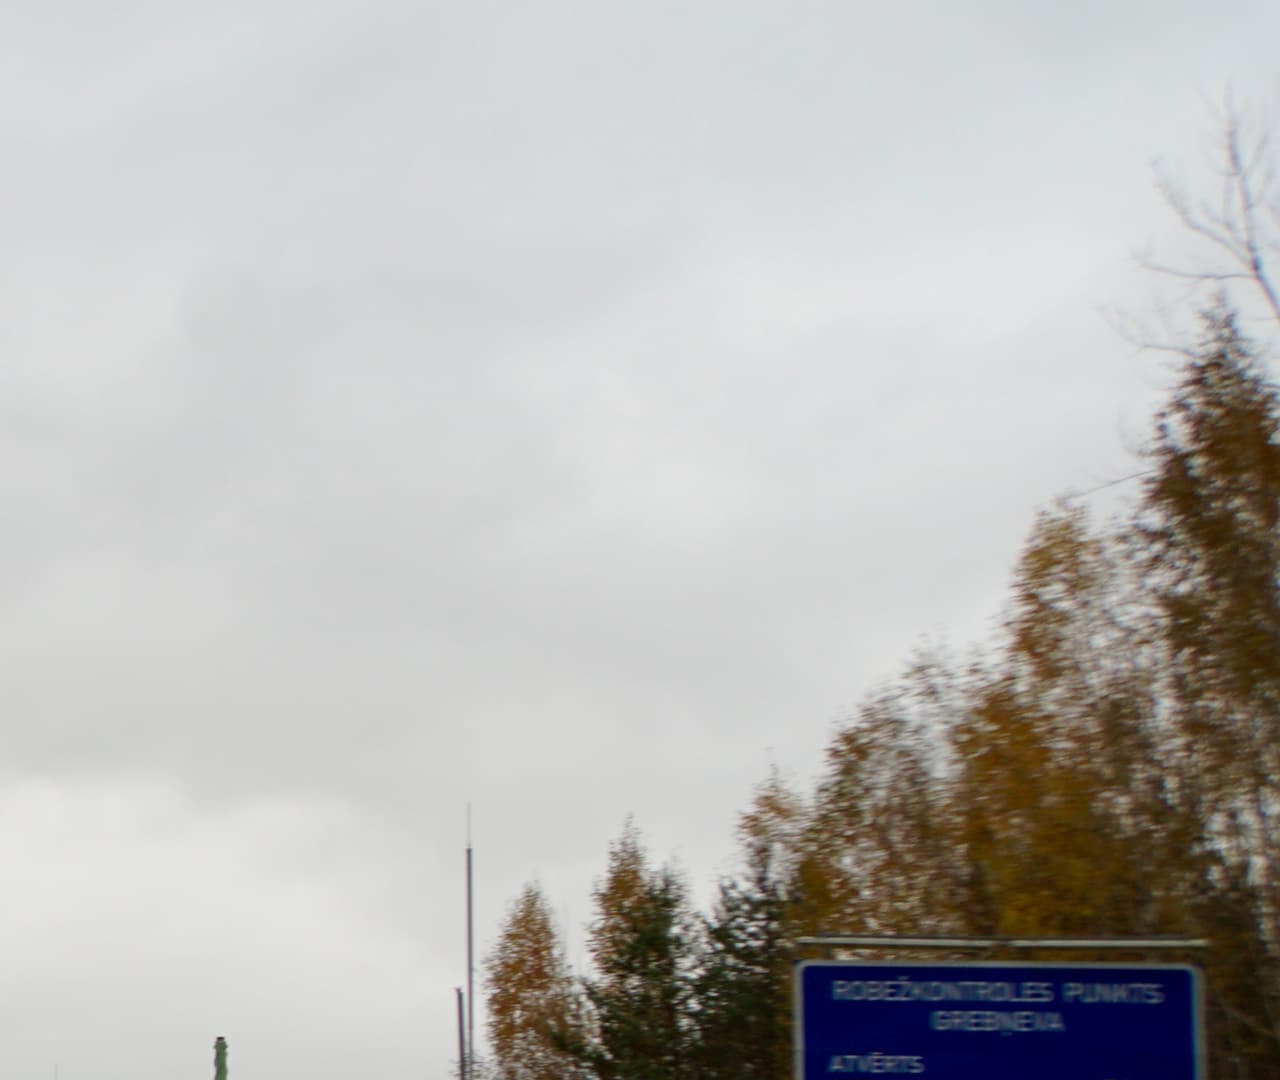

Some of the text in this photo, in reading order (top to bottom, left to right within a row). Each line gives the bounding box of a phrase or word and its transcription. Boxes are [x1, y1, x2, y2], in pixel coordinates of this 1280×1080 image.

[831, 976, 1165, 1003] ROBEŽKONTROLES PUNKTS
[828, 1052, 925, 1074] ATVĒRTS
